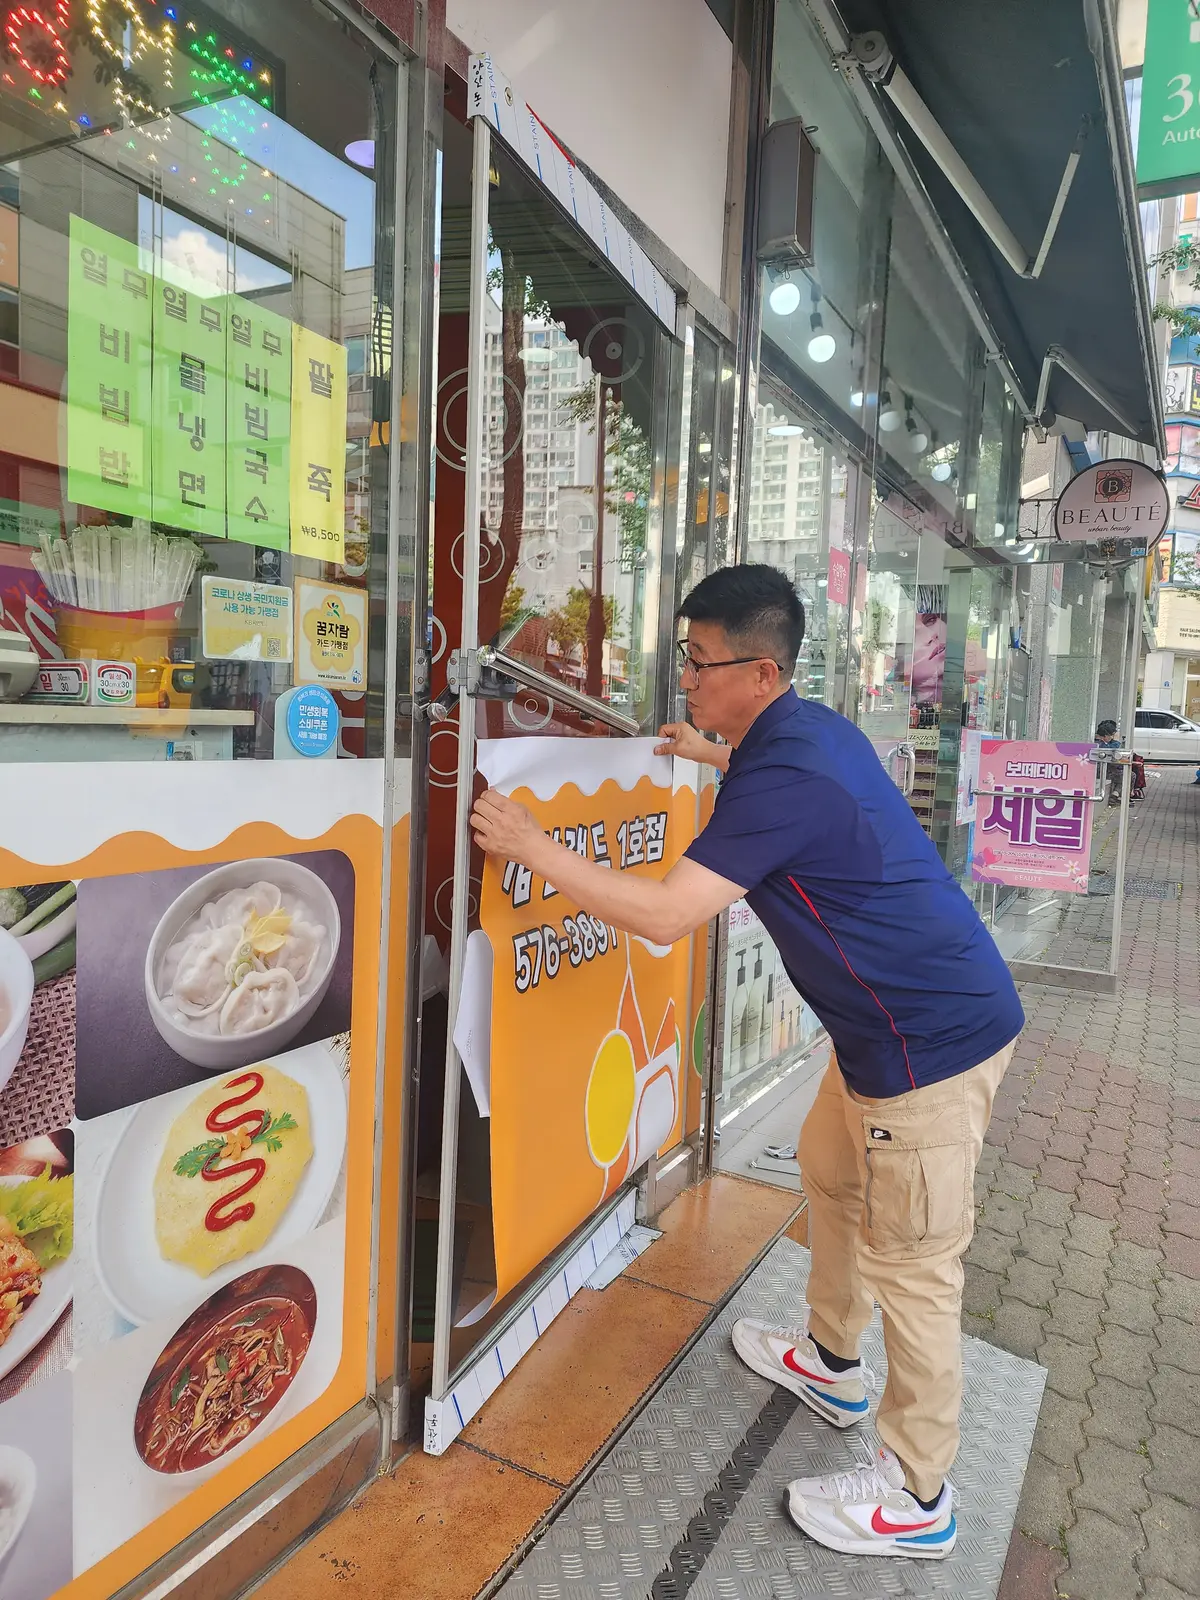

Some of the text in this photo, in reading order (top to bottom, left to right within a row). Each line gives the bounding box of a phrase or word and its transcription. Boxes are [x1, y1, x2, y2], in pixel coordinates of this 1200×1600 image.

[1163, 73, 1200, 123] 3
[162, 285, 222, 509] 열무 물냉면
[230, 312, 283, 524] 열무 비빔국수
[1062, 501, 1161, 525] BEAUTÉ
[300, 524, 341, 543] ₩8,500
[1110, 524, 1132, 535] beauty
[211, 587, 235, 602] 코로나
[253, 592, 289, 608] 국민지원금
[223, 602, 279, 619] 사용 가능 가맹점
[316, 621, 350, 640] 꿈자람
[316, 638, 349, 651] 카드 가맹점
[299, 704, 329, 718] 민생회복
[298, 718, 328, 731] 소비쿠폰
[1005, 761, 1069, 780] 보떼데이
[982, 784, 1086, 850] 세일
[616, 811, 668, 869] 1호점
